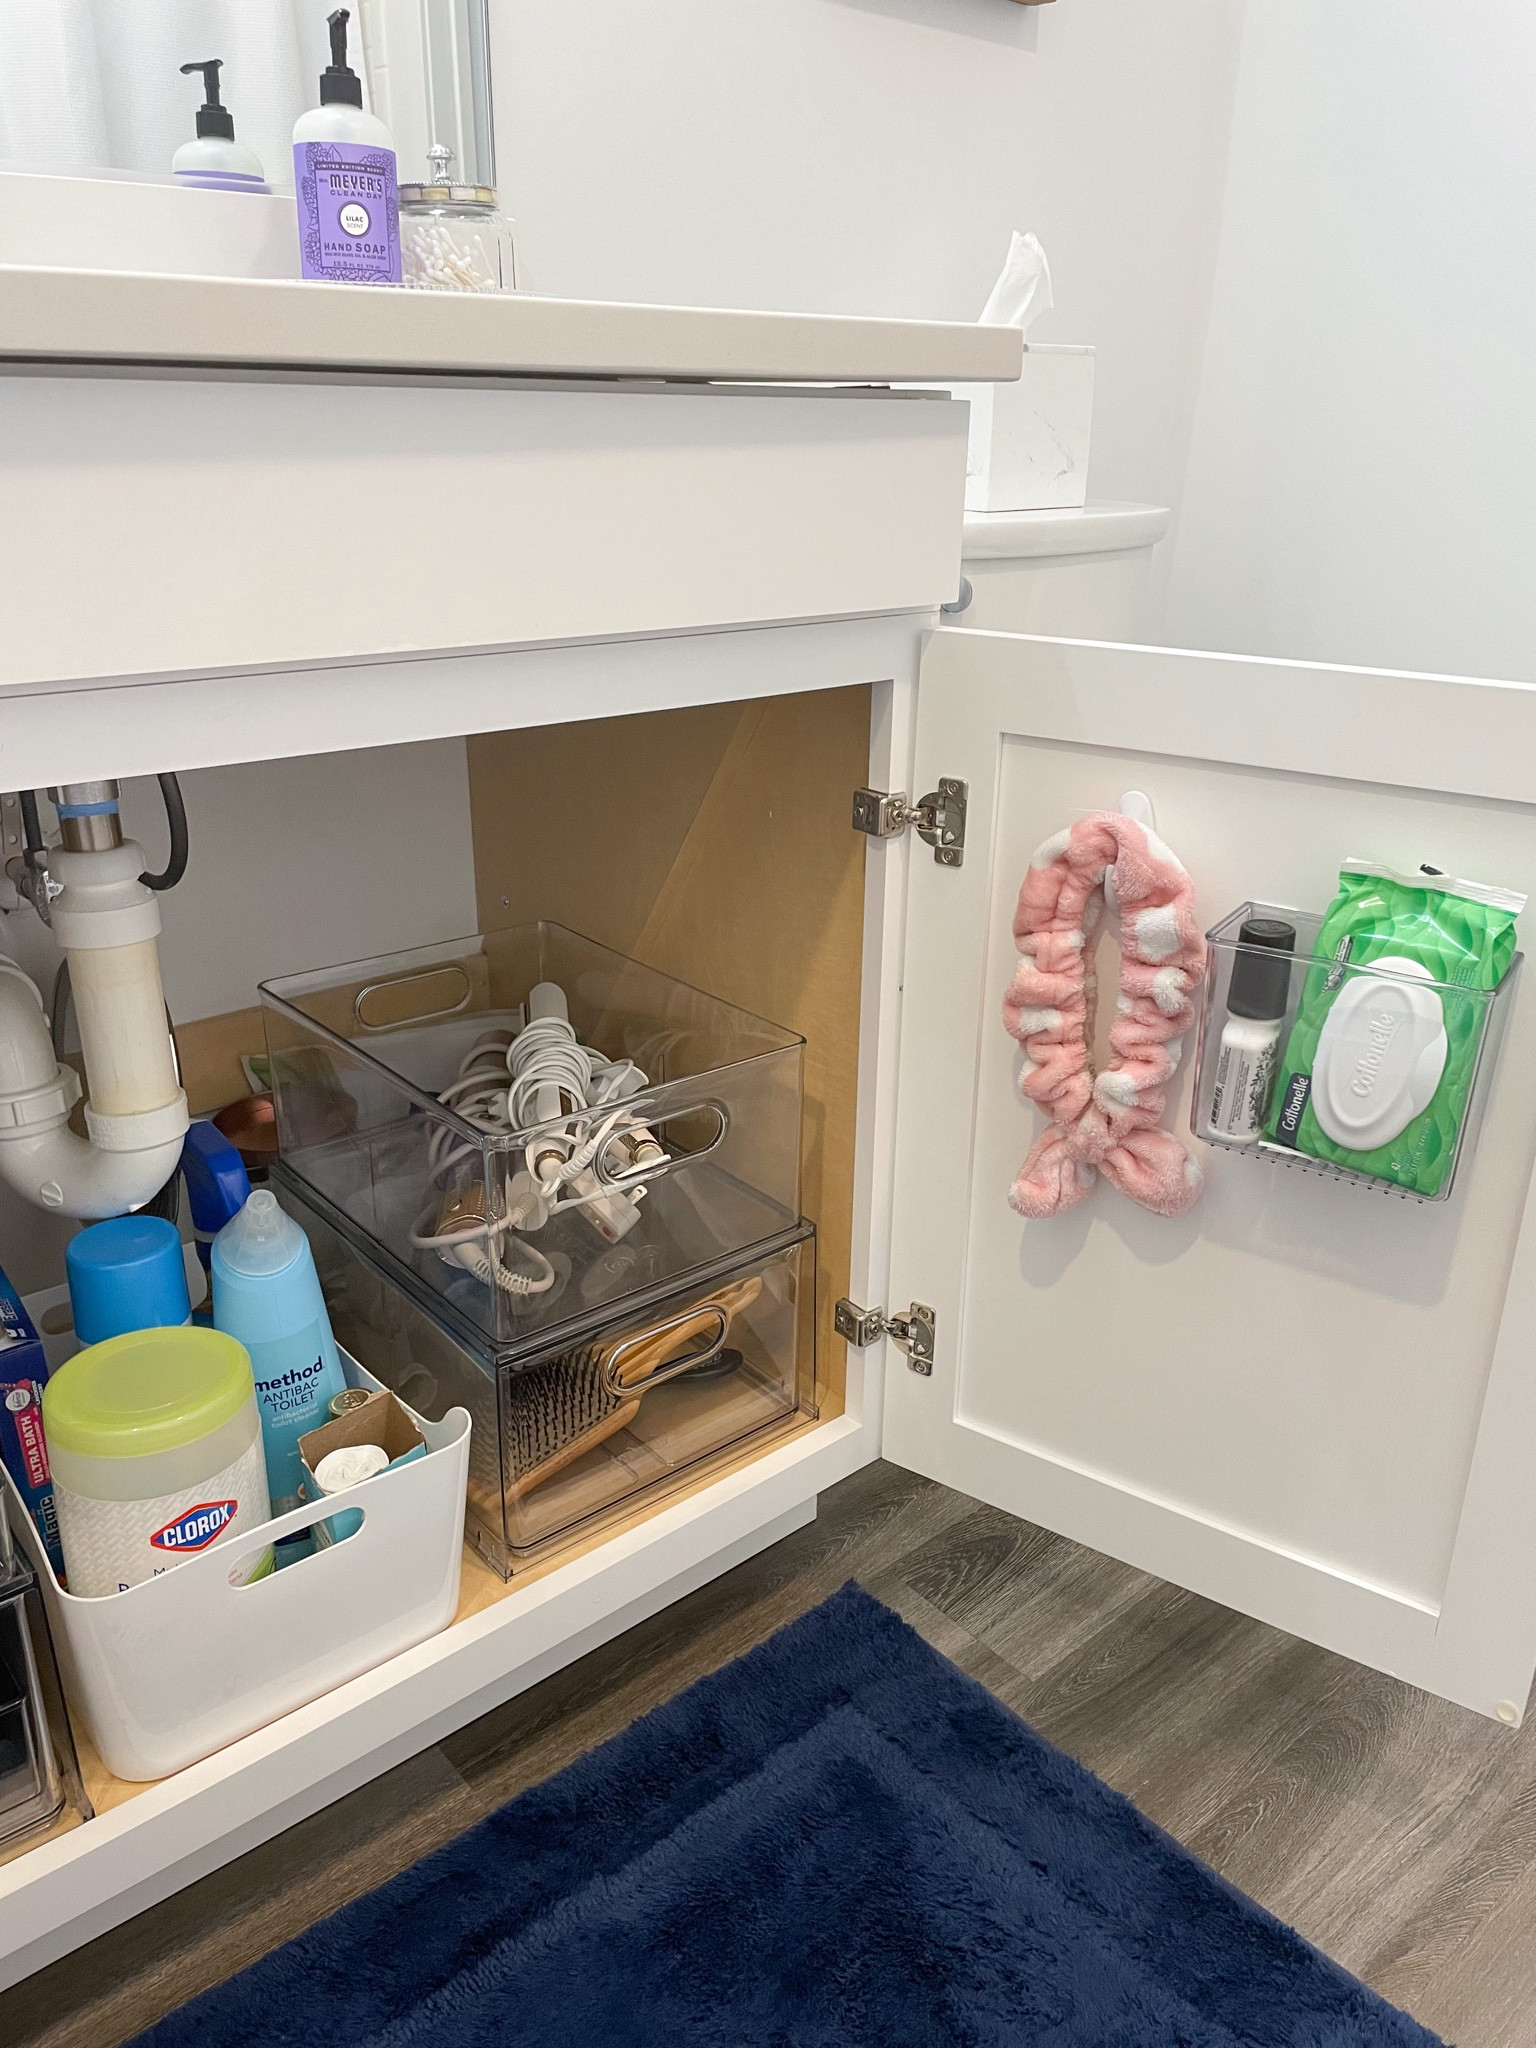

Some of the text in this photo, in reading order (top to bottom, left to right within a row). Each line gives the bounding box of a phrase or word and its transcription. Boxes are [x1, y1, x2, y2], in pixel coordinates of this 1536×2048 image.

[330, 174, 382, 194] MEYER'S
[324, 243, 386, 255] HAND SOAP
[1351, 1014, 1394, 1098] Cottonelle
[1281, 1077, 1309, 1131] Cottonelle
[255, 1355, 323, 1393] method
[263, 1377, 320, 1404] ANTIBAC
[271, 1390, 316, 1413] TOILET
[271, 1408, 319, 1429] toilet cleaner
[272, 1401, 318, 1422] antibacterial
[20, 1415, 45, 1484] ULTRA BATH
[163, 1503, 230, 1548] CLOROX
